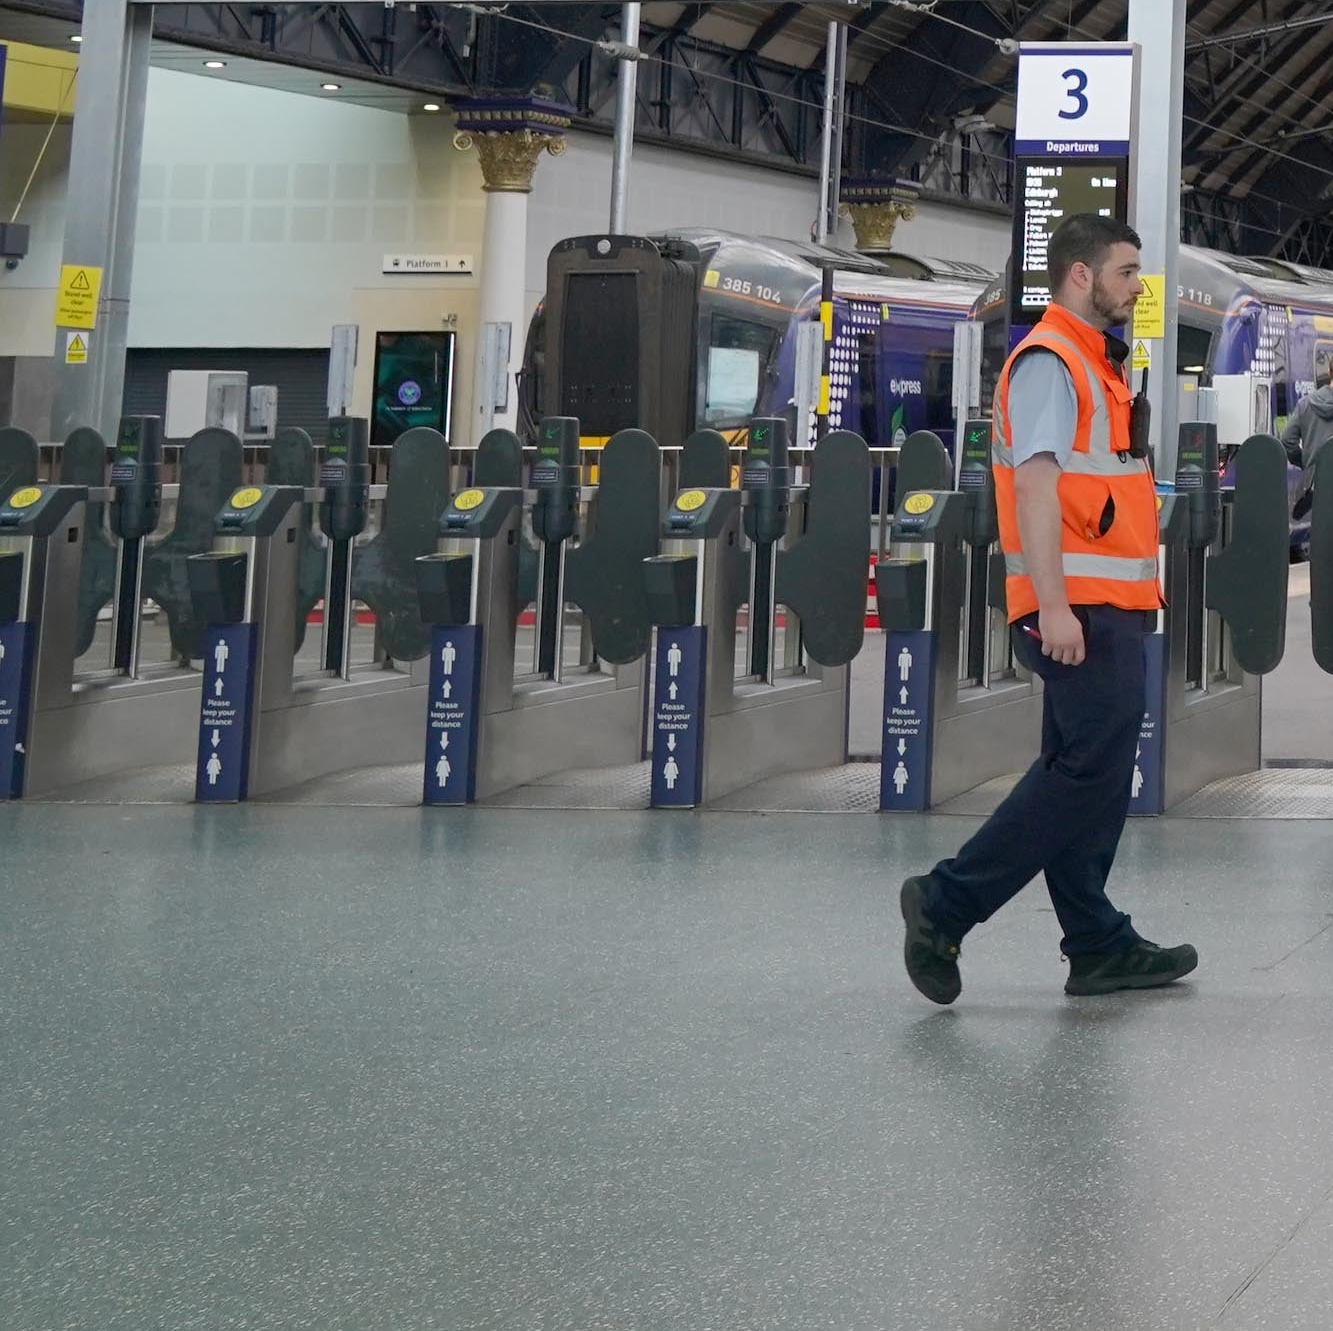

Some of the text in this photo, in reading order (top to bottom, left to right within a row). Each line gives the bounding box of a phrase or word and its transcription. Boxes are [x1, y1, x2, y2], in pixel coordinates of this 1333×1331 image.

[1057, 69, 1089, 120] 3
[1046, 142, 1100, 154] Departures
[406, 259, 441, 270] Platform
[722, 277, 782, 304] 385 104
[1188, 287, 1212, 306] 118
[890, 378, 922, 395] express
[435, 701, 459, 710] Please
[430, 711, 465, 720] keep your
[431, 720, 462, 729] distance
